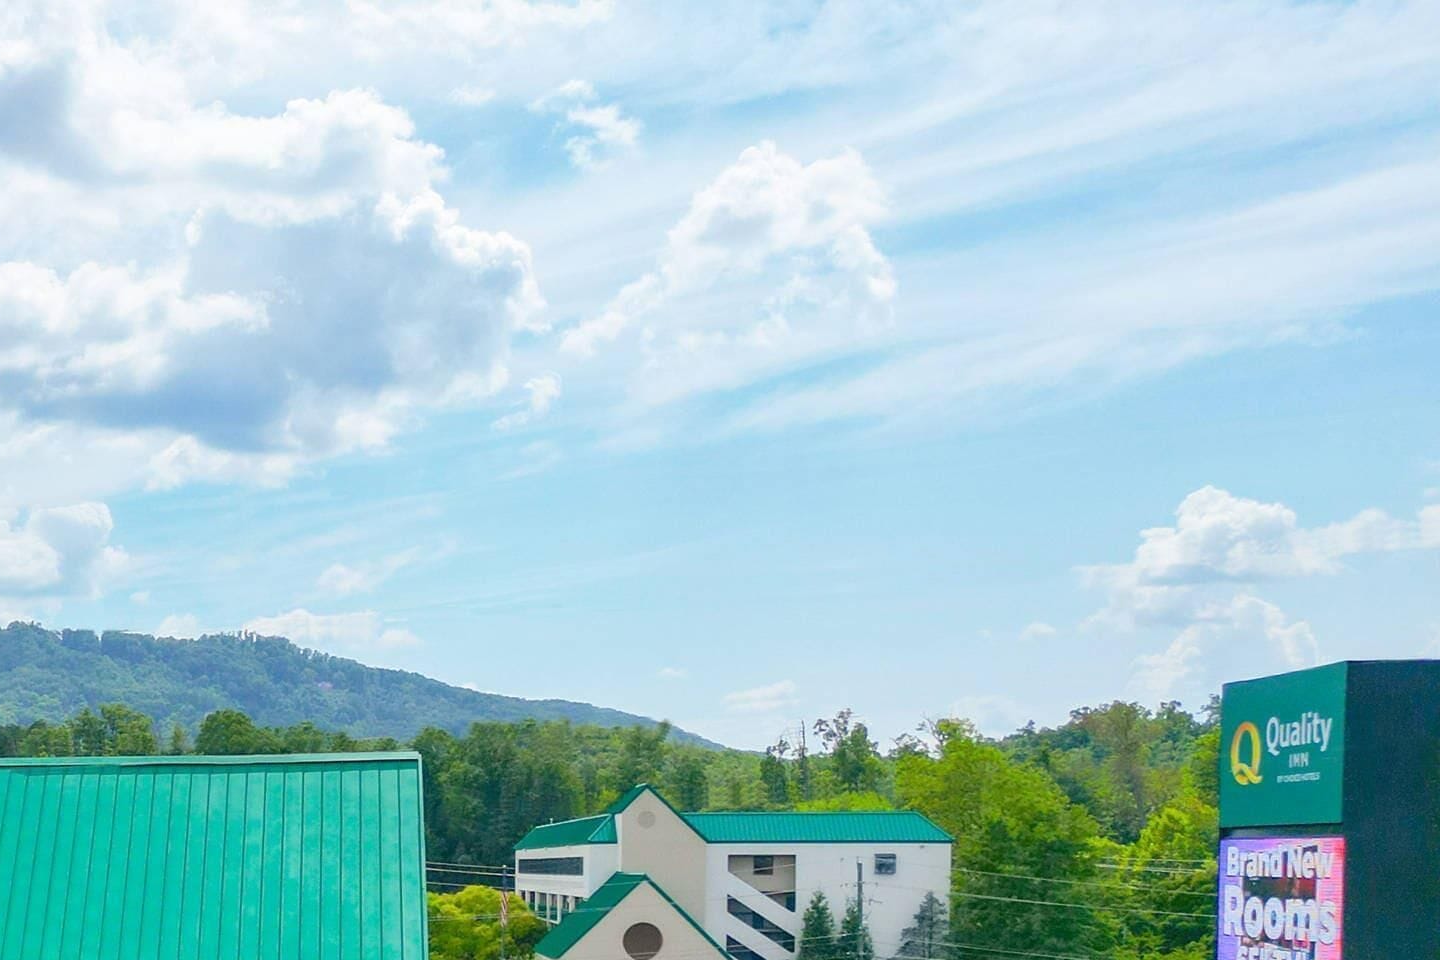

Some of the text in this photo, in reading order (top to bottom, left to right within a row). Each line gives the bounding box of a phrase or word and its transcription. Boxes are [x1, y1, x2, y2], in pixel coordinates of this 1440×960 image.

[1231, 721, 1263, 785] Q
[1266, 711, 1332, 757] Quality
[1288, 752, 1309, 768] INN
[1227, 843, 1334, 879] Brand New
[1224, 885, 1337, 945] Rooms
